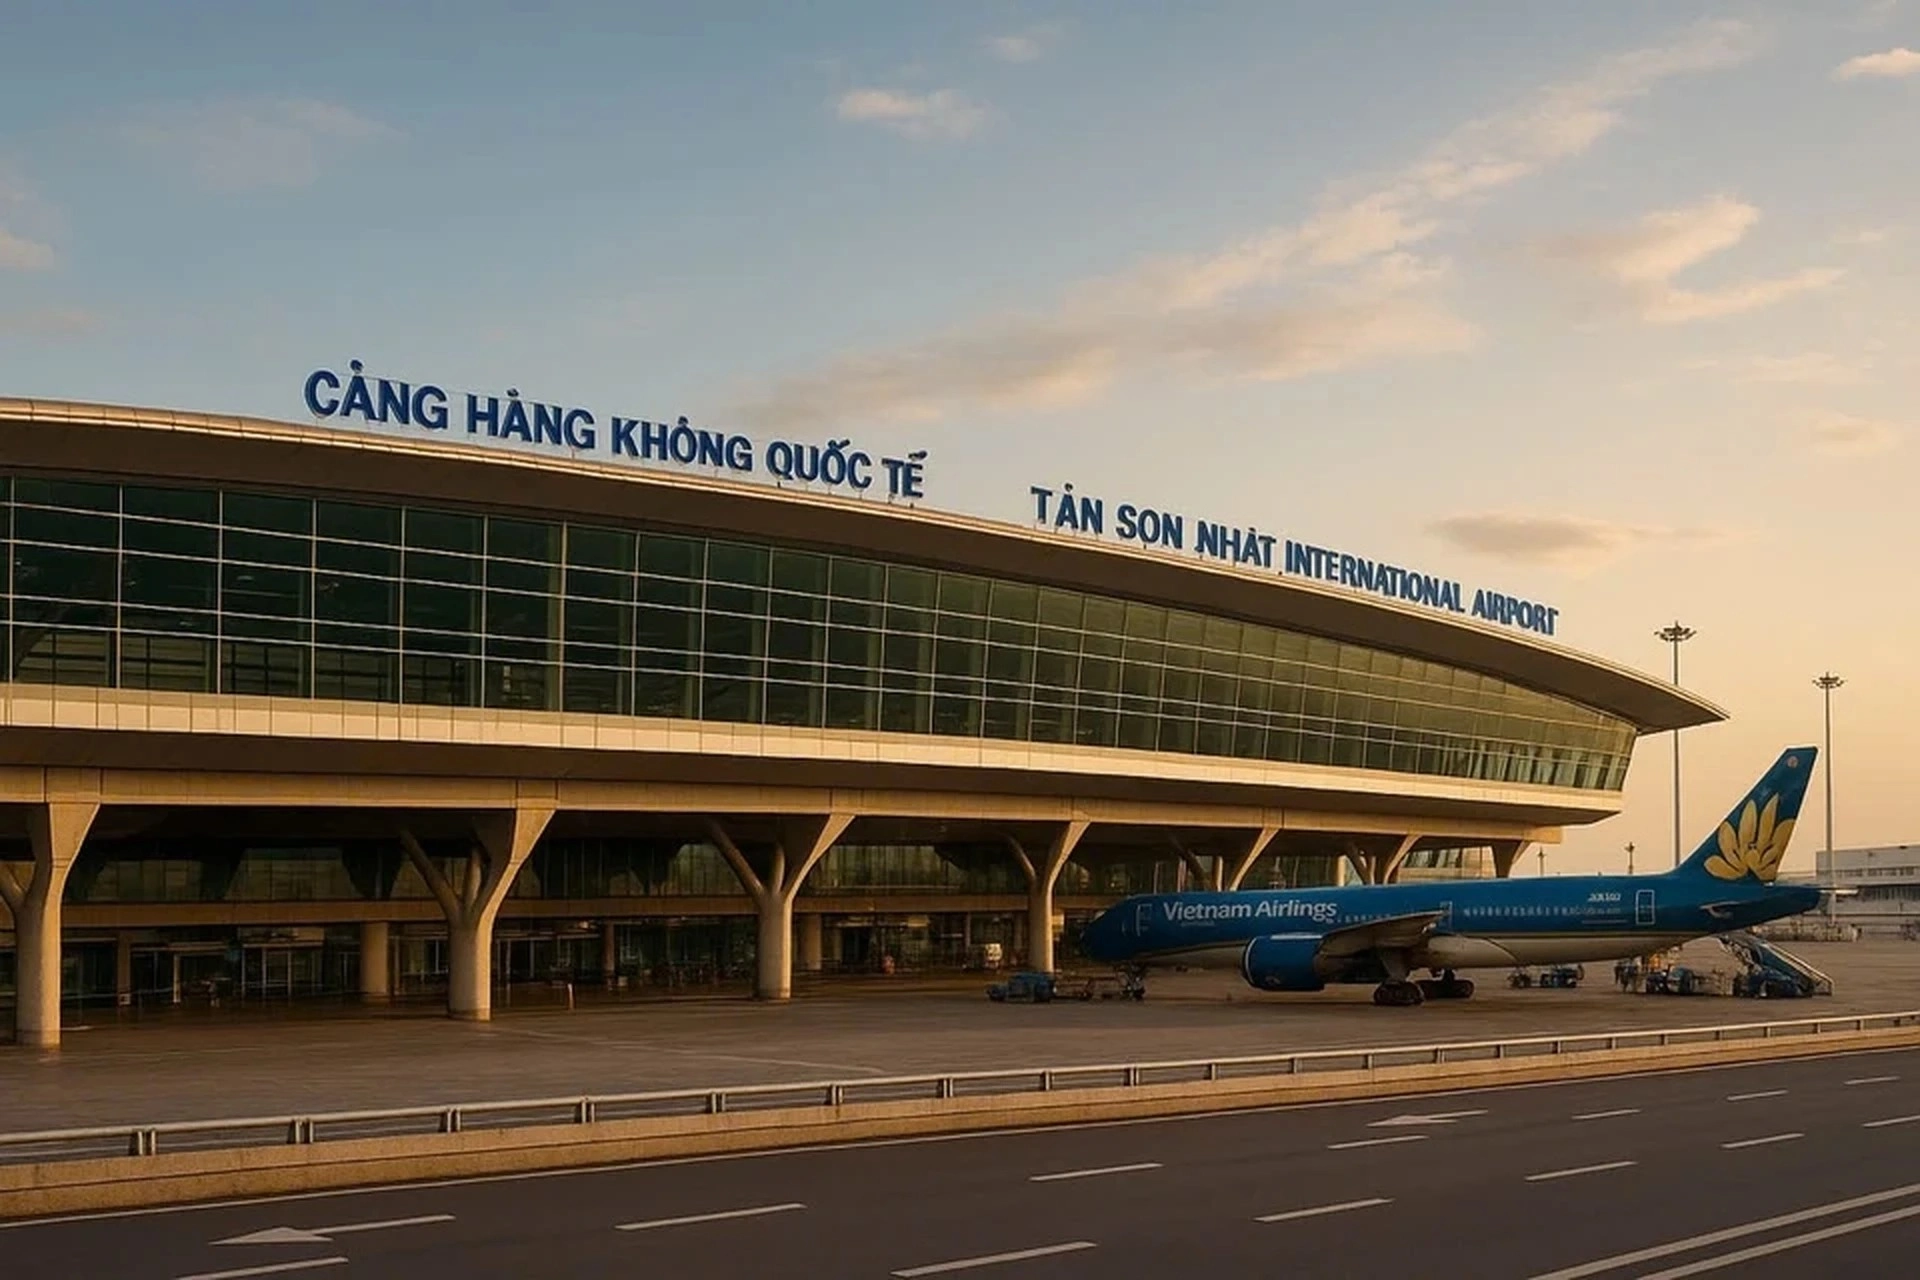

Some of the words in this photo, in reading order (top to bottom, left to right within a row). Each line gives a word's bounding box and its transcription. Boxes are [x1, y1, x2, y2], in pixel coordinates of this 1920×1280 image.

[1285, 540, 1466, 613] INTERNATIONAL
[1471, 588, 1559, 636] AIRPORT
[1163, 901, 1252, 921] Vietnam
